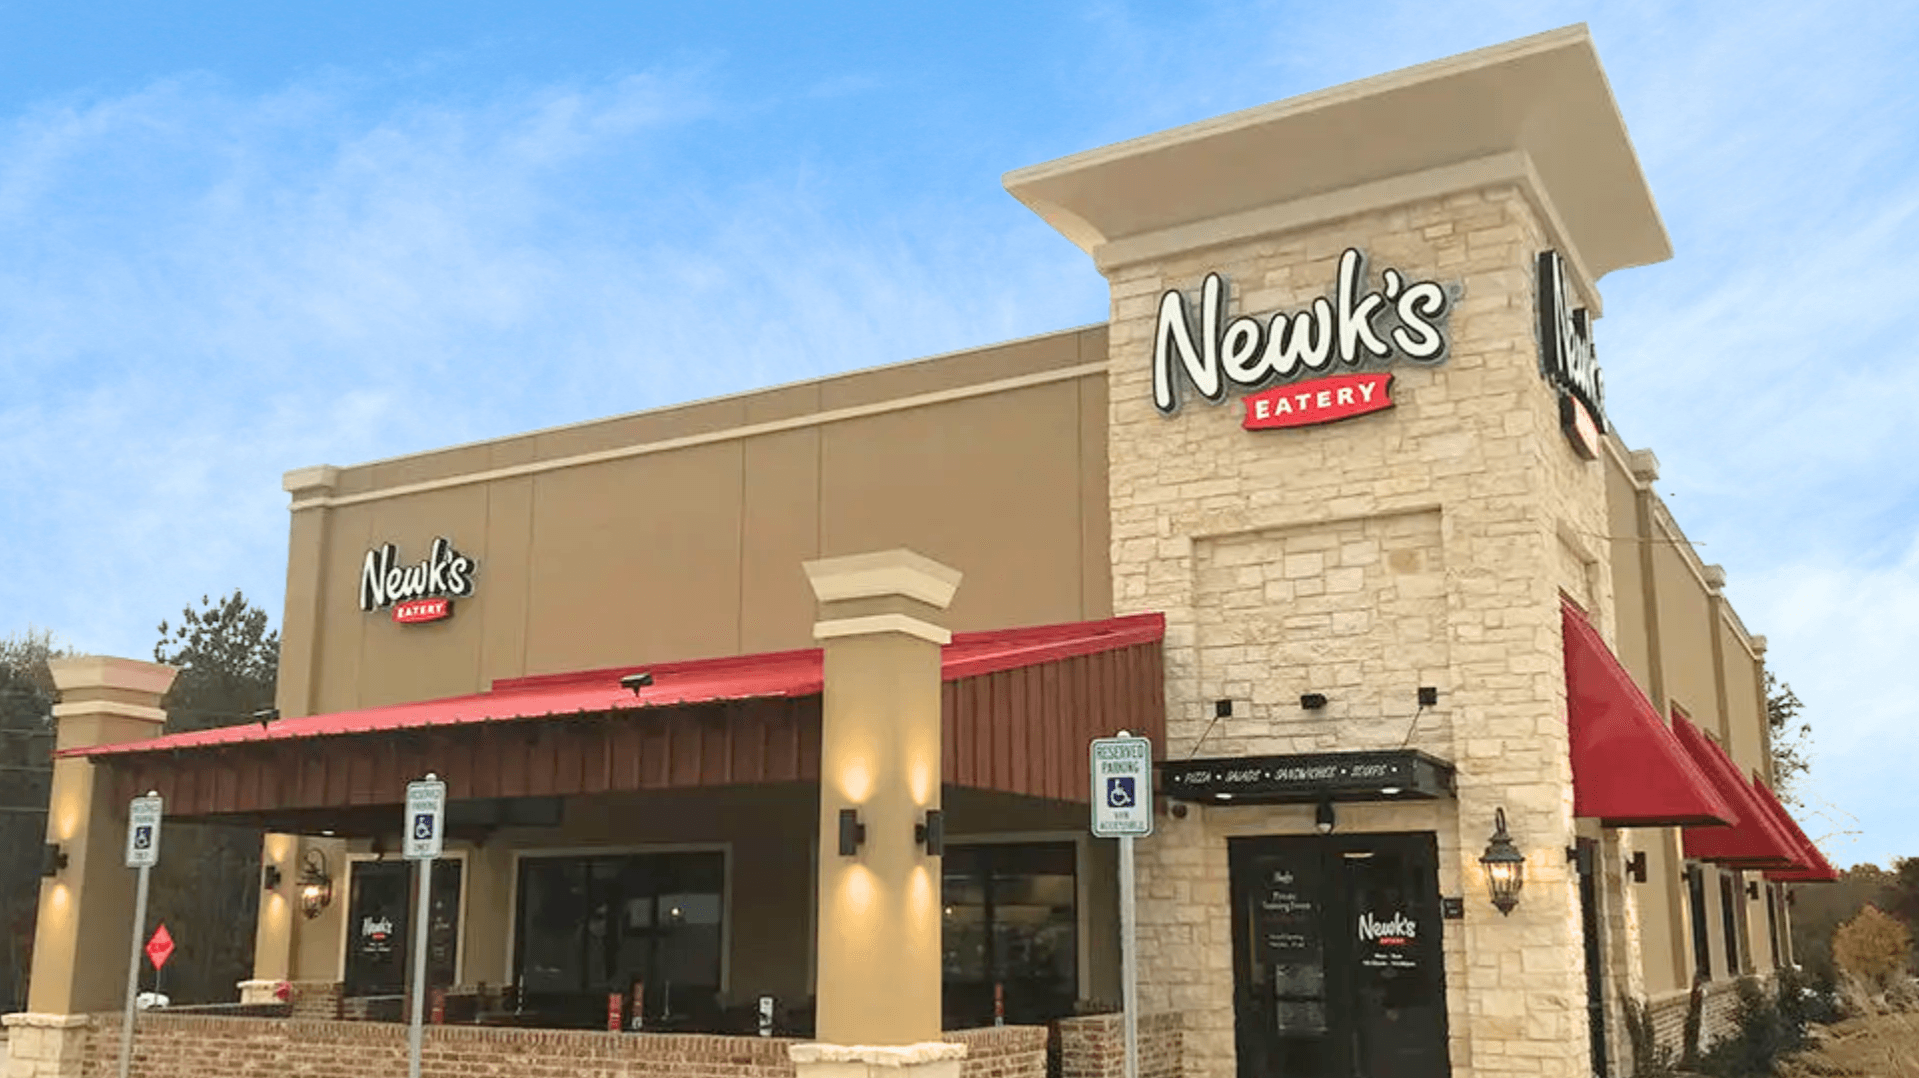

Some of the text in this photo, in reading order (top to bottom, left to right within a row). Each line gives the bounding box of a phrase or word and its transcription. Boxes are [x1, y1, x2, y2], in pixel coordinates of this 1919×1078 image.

[1153, 248, 1445, 411] Newk's
[1255, 381, 1376, 420] EATERY
[361, 538, 468, 610] Newk's
[397, 603, 444, 618] EATERY
[1359, 911, 1416, 941] Newk's
